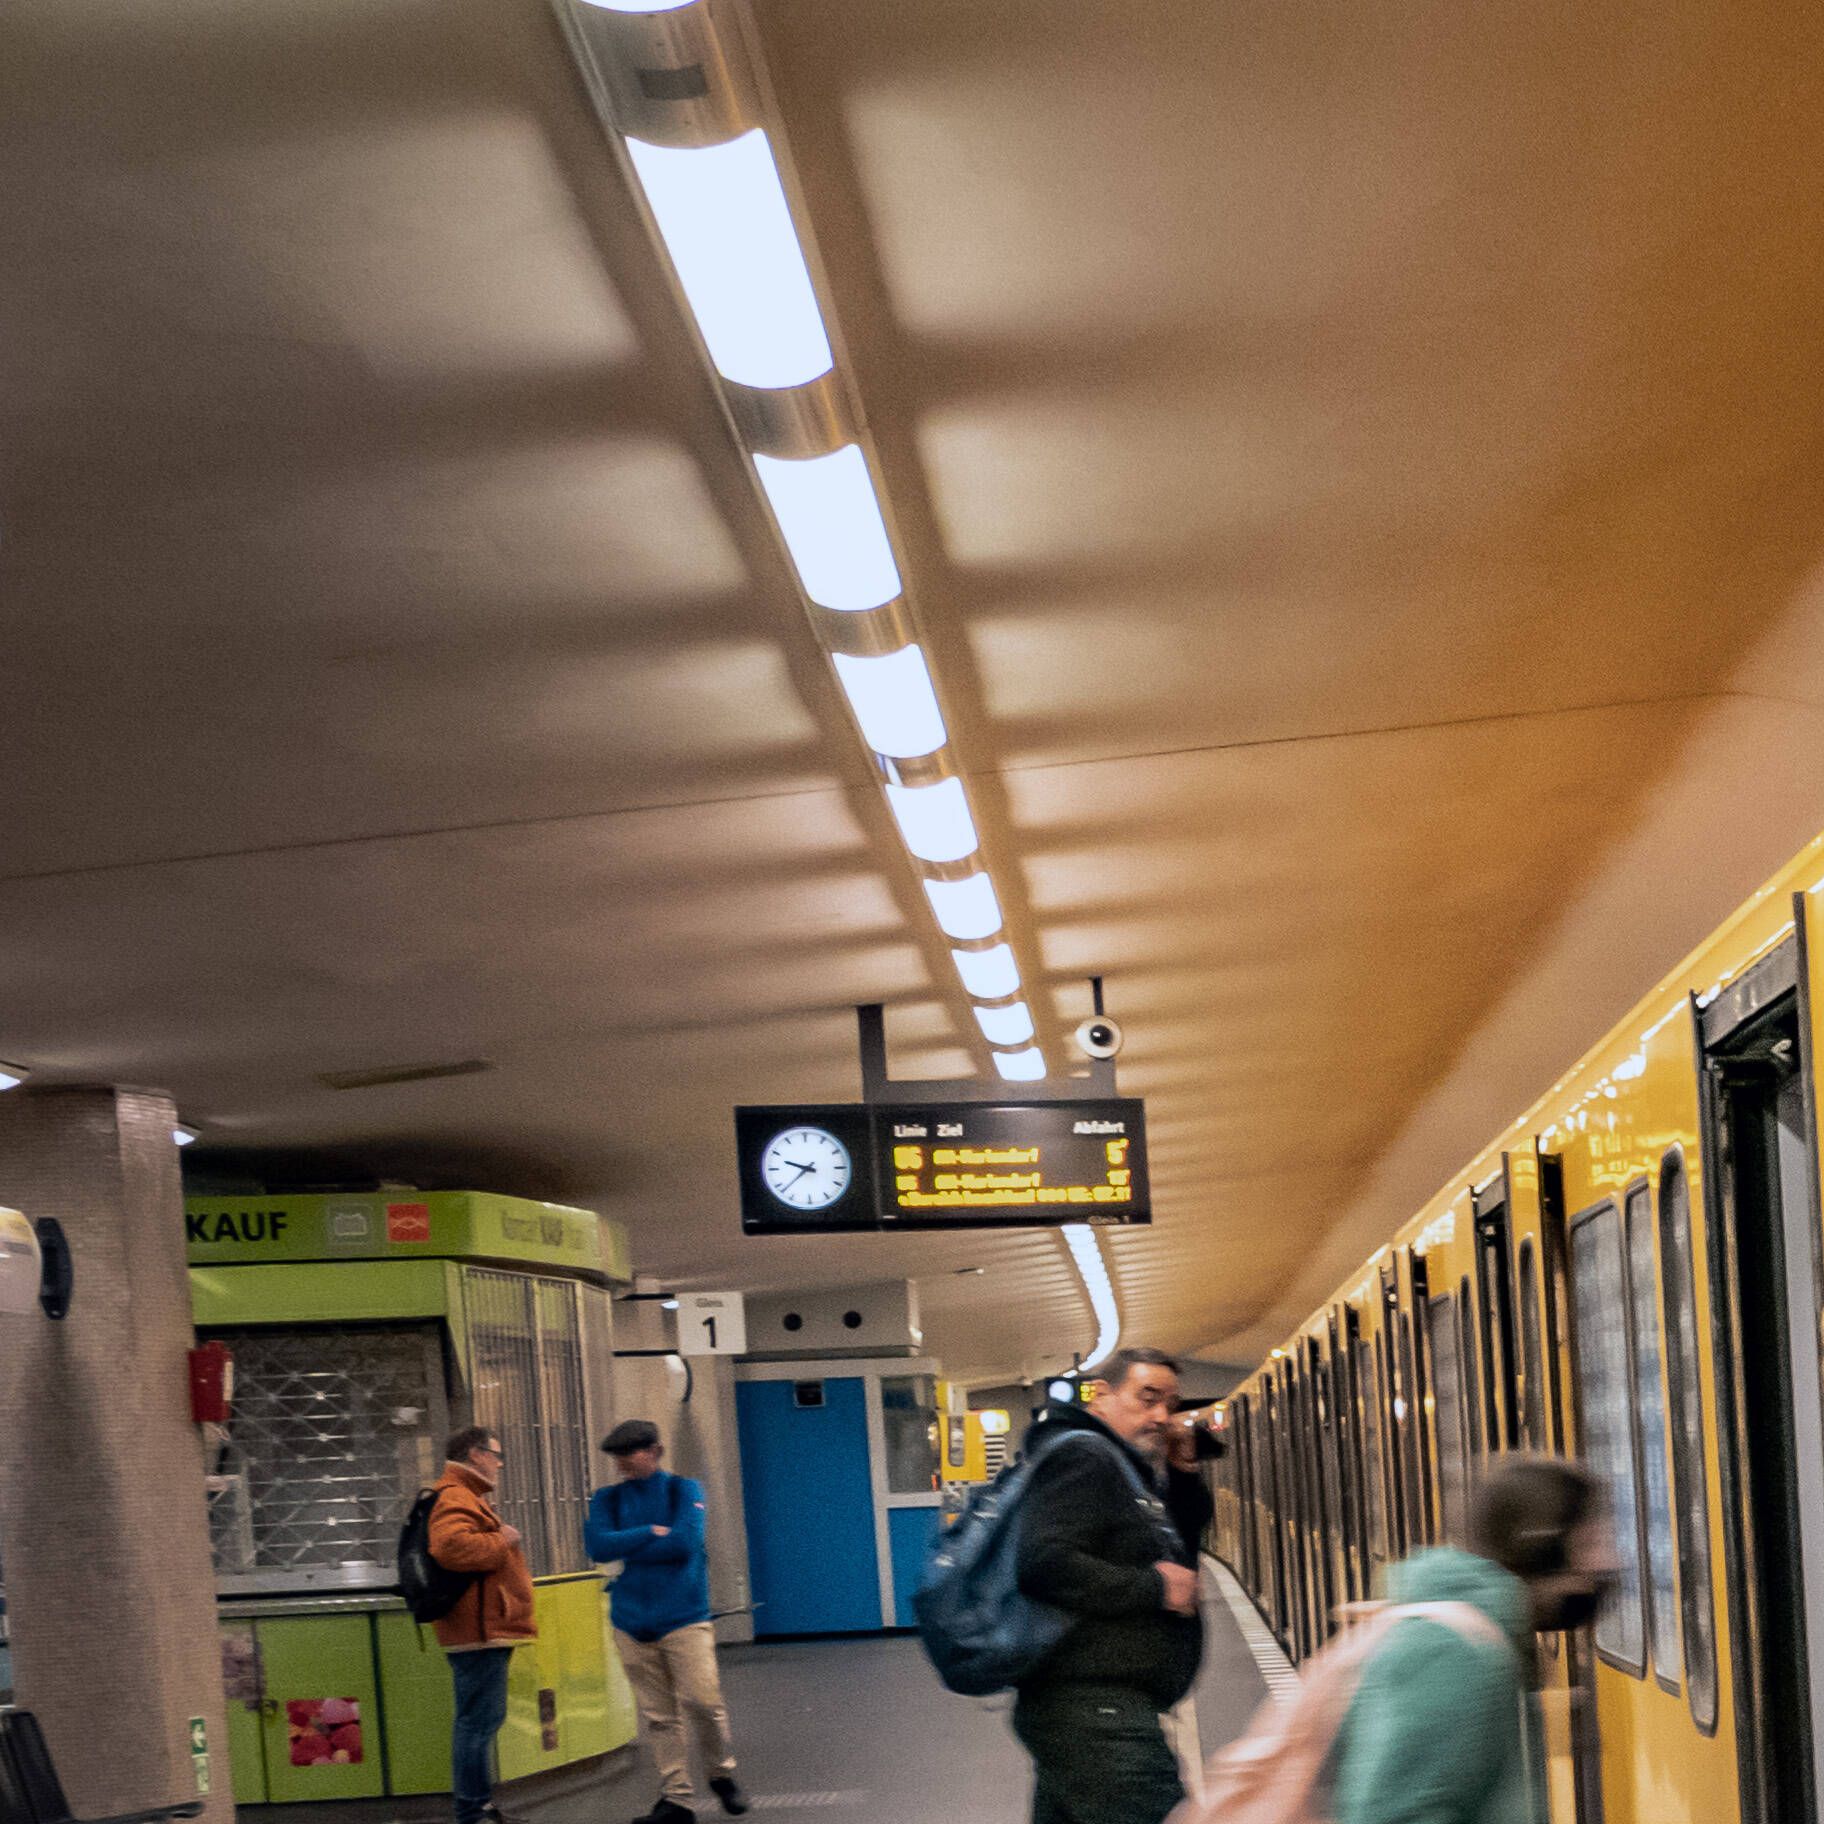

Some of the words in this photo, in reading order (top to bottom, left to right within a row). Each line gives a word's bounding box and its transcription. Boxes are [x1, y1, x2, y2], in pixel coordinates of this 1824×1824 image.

[894, 1124, 927, 1137] Linie
[937, 1123, 963, 1137] Ziel
[1073, 1120, 1125, 1134] Abfahrt
[185, 1211, 288, 1241] KAUF
[702, 1316, 716, 1348] 1
